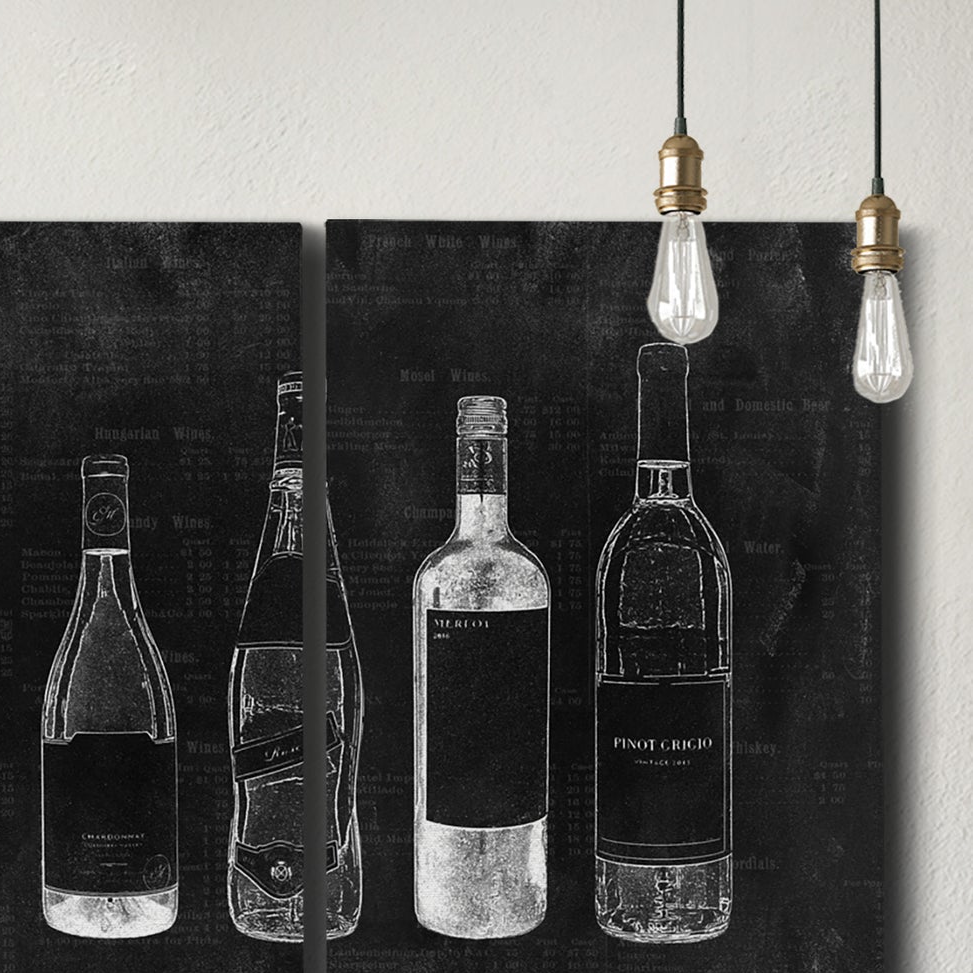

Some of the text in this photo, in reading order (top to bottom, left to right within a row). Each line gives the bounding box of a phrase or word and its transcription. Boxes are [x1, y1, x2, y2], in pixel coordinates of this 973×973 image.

[744, 542, 785, 554] Water.
[613, 736, 713, 752] PINOT GRIGIO
